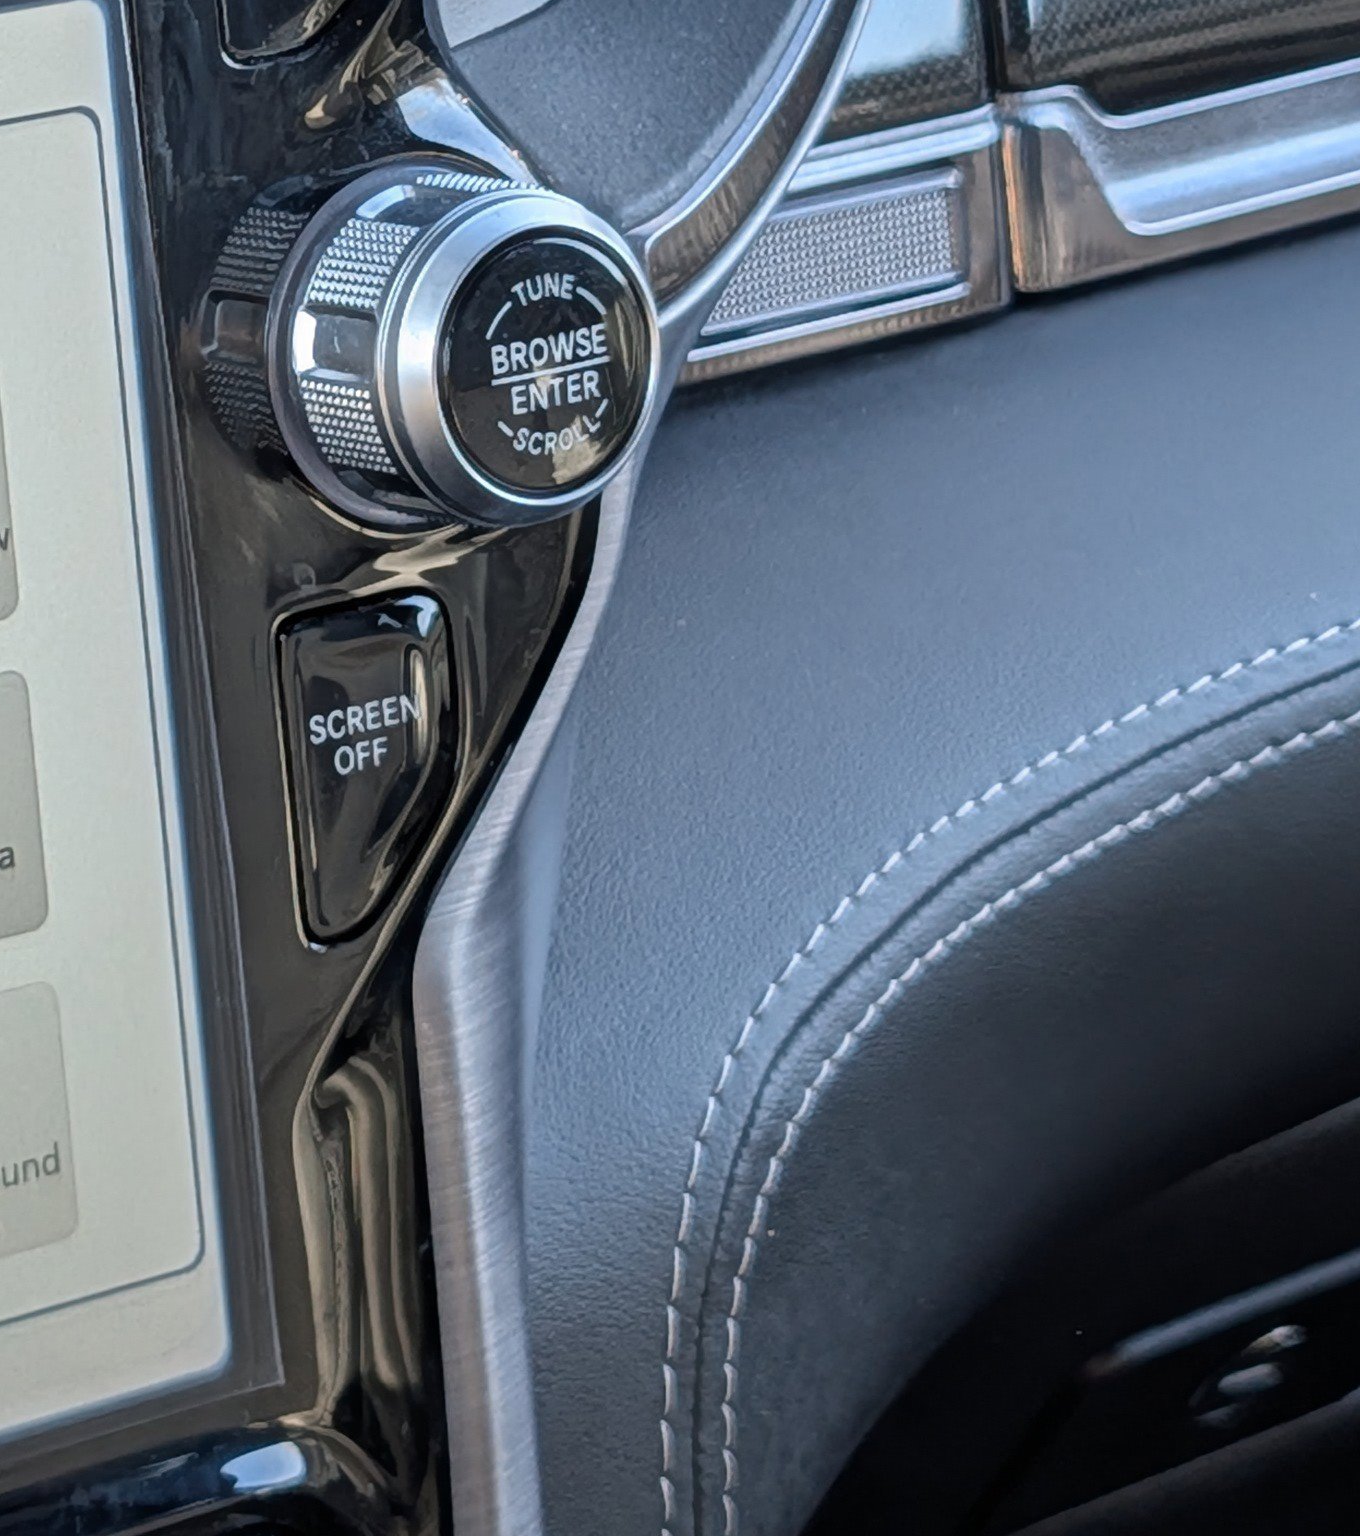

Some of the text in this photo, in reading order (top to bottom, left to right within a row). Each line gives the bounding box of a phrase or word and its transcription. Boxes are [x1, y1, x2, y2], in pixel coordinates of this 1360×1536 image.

[512, 273, 576, 304] TUNE
[491, 324, 608, 374] BROWSE
[511, 372, 600, 414] ENTER
[513, 414, 602, 457] SCROLL
[308, 694, 420, 745] SCREEN
[333, 742, 390, 775] OFF
